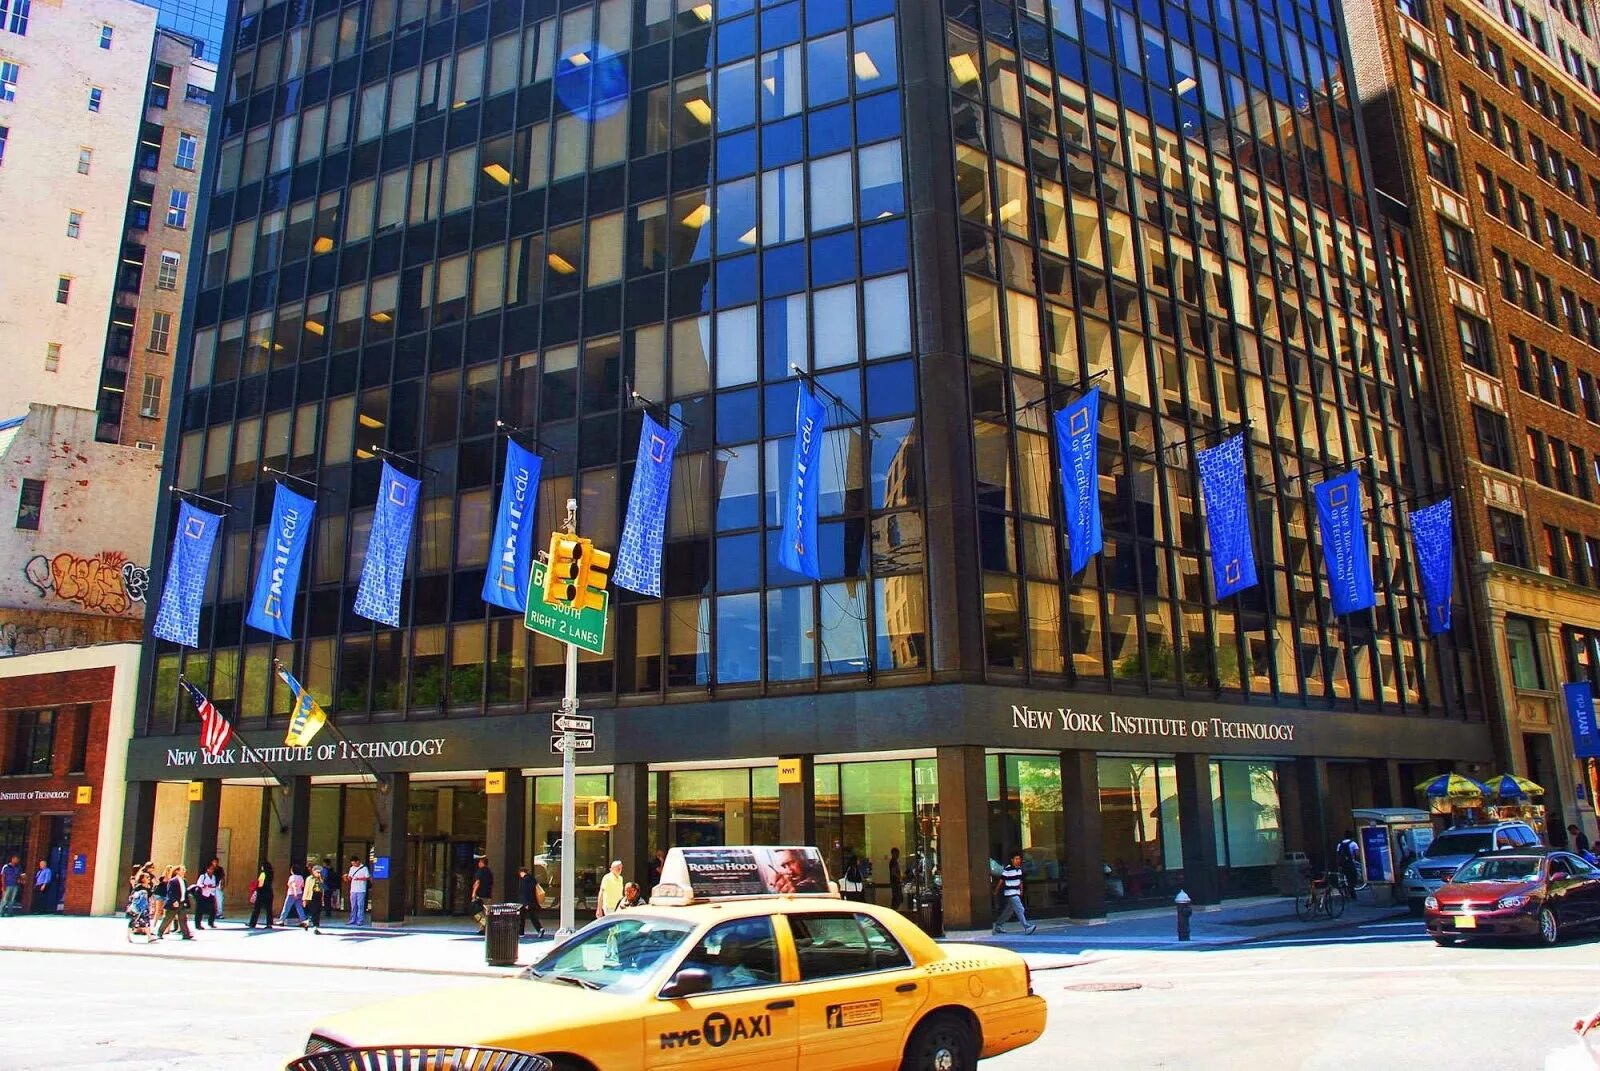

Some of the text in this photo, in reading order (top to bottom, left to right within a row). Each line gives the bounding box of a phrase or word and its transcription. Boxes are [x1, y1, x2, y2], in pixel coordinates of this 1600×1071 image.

[530, 610, 599, 645] RIGHT 2 LANES
[575, 721, 589, 729] WAY
[1011, 705, 1295, 741] NEW YORK INSTITUTE OF TECHNOLOGY
[166, 738, 446, 768] NEW YORK INSTITUTE OF TECHNOLOGY
[0, 791, 27, 800] INSTITUTE
[35, 790, 71, 799] TECHNOLOGY
[688, 863, 758, 872] ROBIN HOOD
[660, 1011, 772, 1049] NYC TAXI
